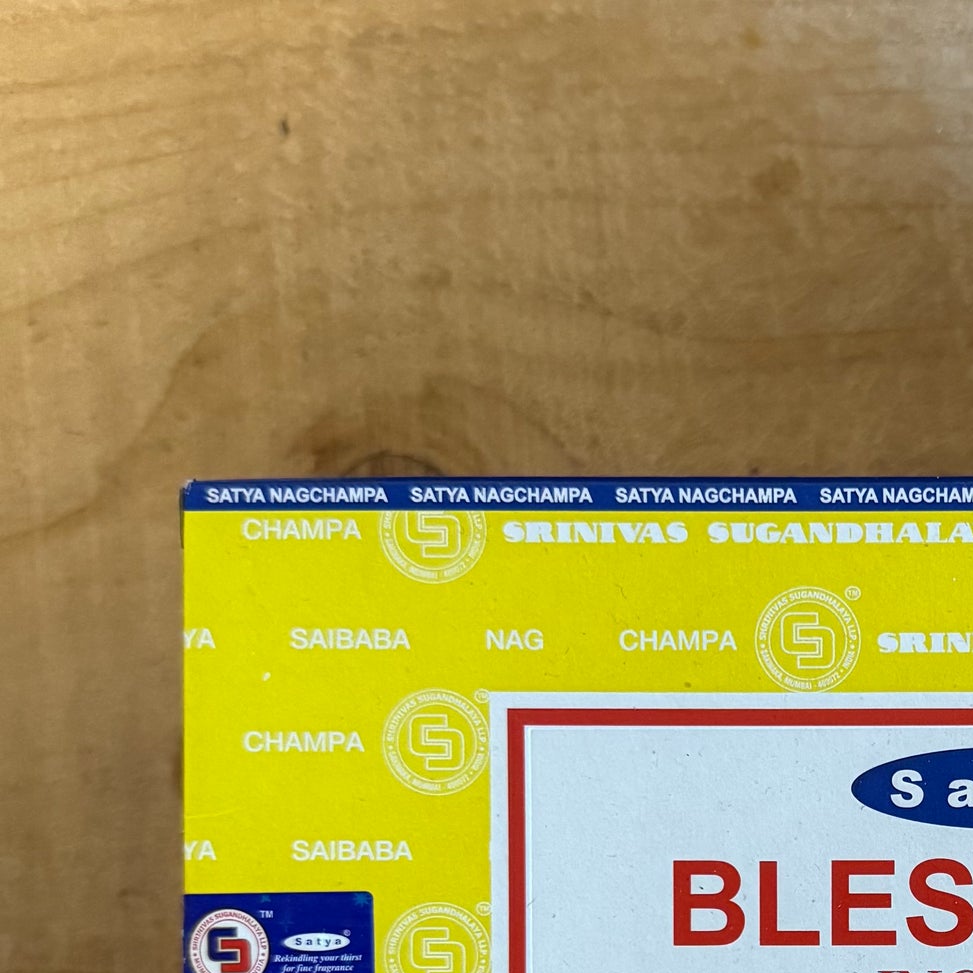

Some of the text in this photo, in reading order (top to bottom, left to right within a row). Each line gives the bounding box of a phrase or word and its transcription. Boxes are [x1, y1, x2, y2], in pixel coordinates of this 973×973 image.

[208, 488, 387, 502] SATYA NAGCHAMPA
[412, 488, 592, 502] SATYA NAGCHAMPA
[616, 488, 796, 503] SATYA NAGCHAMPA
[821, 488, 878, 503] SATYA
[242, 518, 361, 540] CHAMPA
[502, 521, 688, 543] SRINIVAS
[290, 628, 410, 649] SAIBABA
[486, 629, 543, 650] NAG
[619, 630, 736, 651] CHAMPA
[243, 731, 364, 752] CHAMPA
[292, 840, 412, 861] SAIBABA
[259, 910, 274, 919] TM
[295, 937, 342, 948] Satya
